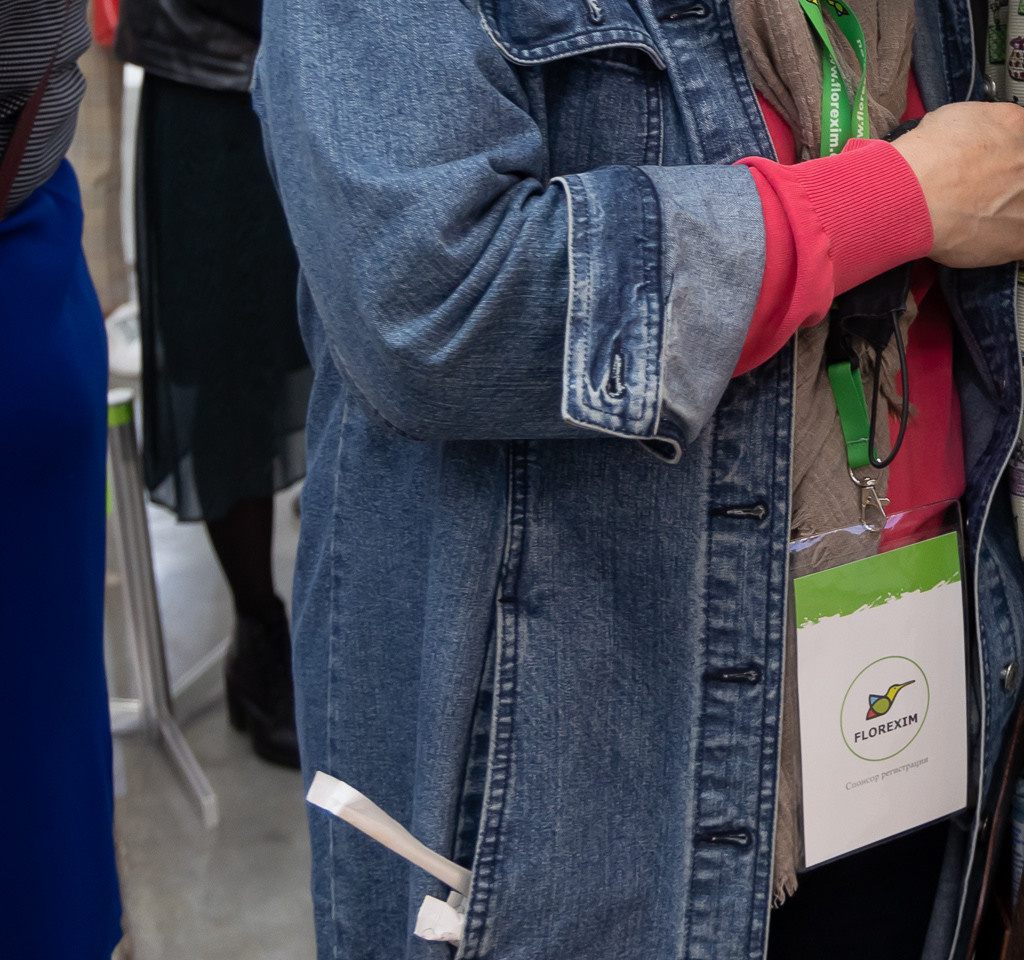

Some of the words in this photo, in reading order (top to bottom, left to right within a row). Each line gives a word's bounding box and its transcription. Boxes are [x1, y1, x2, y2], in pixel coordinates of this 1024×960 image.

[854, 713, 918, 743] FLOREXIM
[845, 774, 880, 791] Спонсор
[881, 757, 929, 780] регистрации
